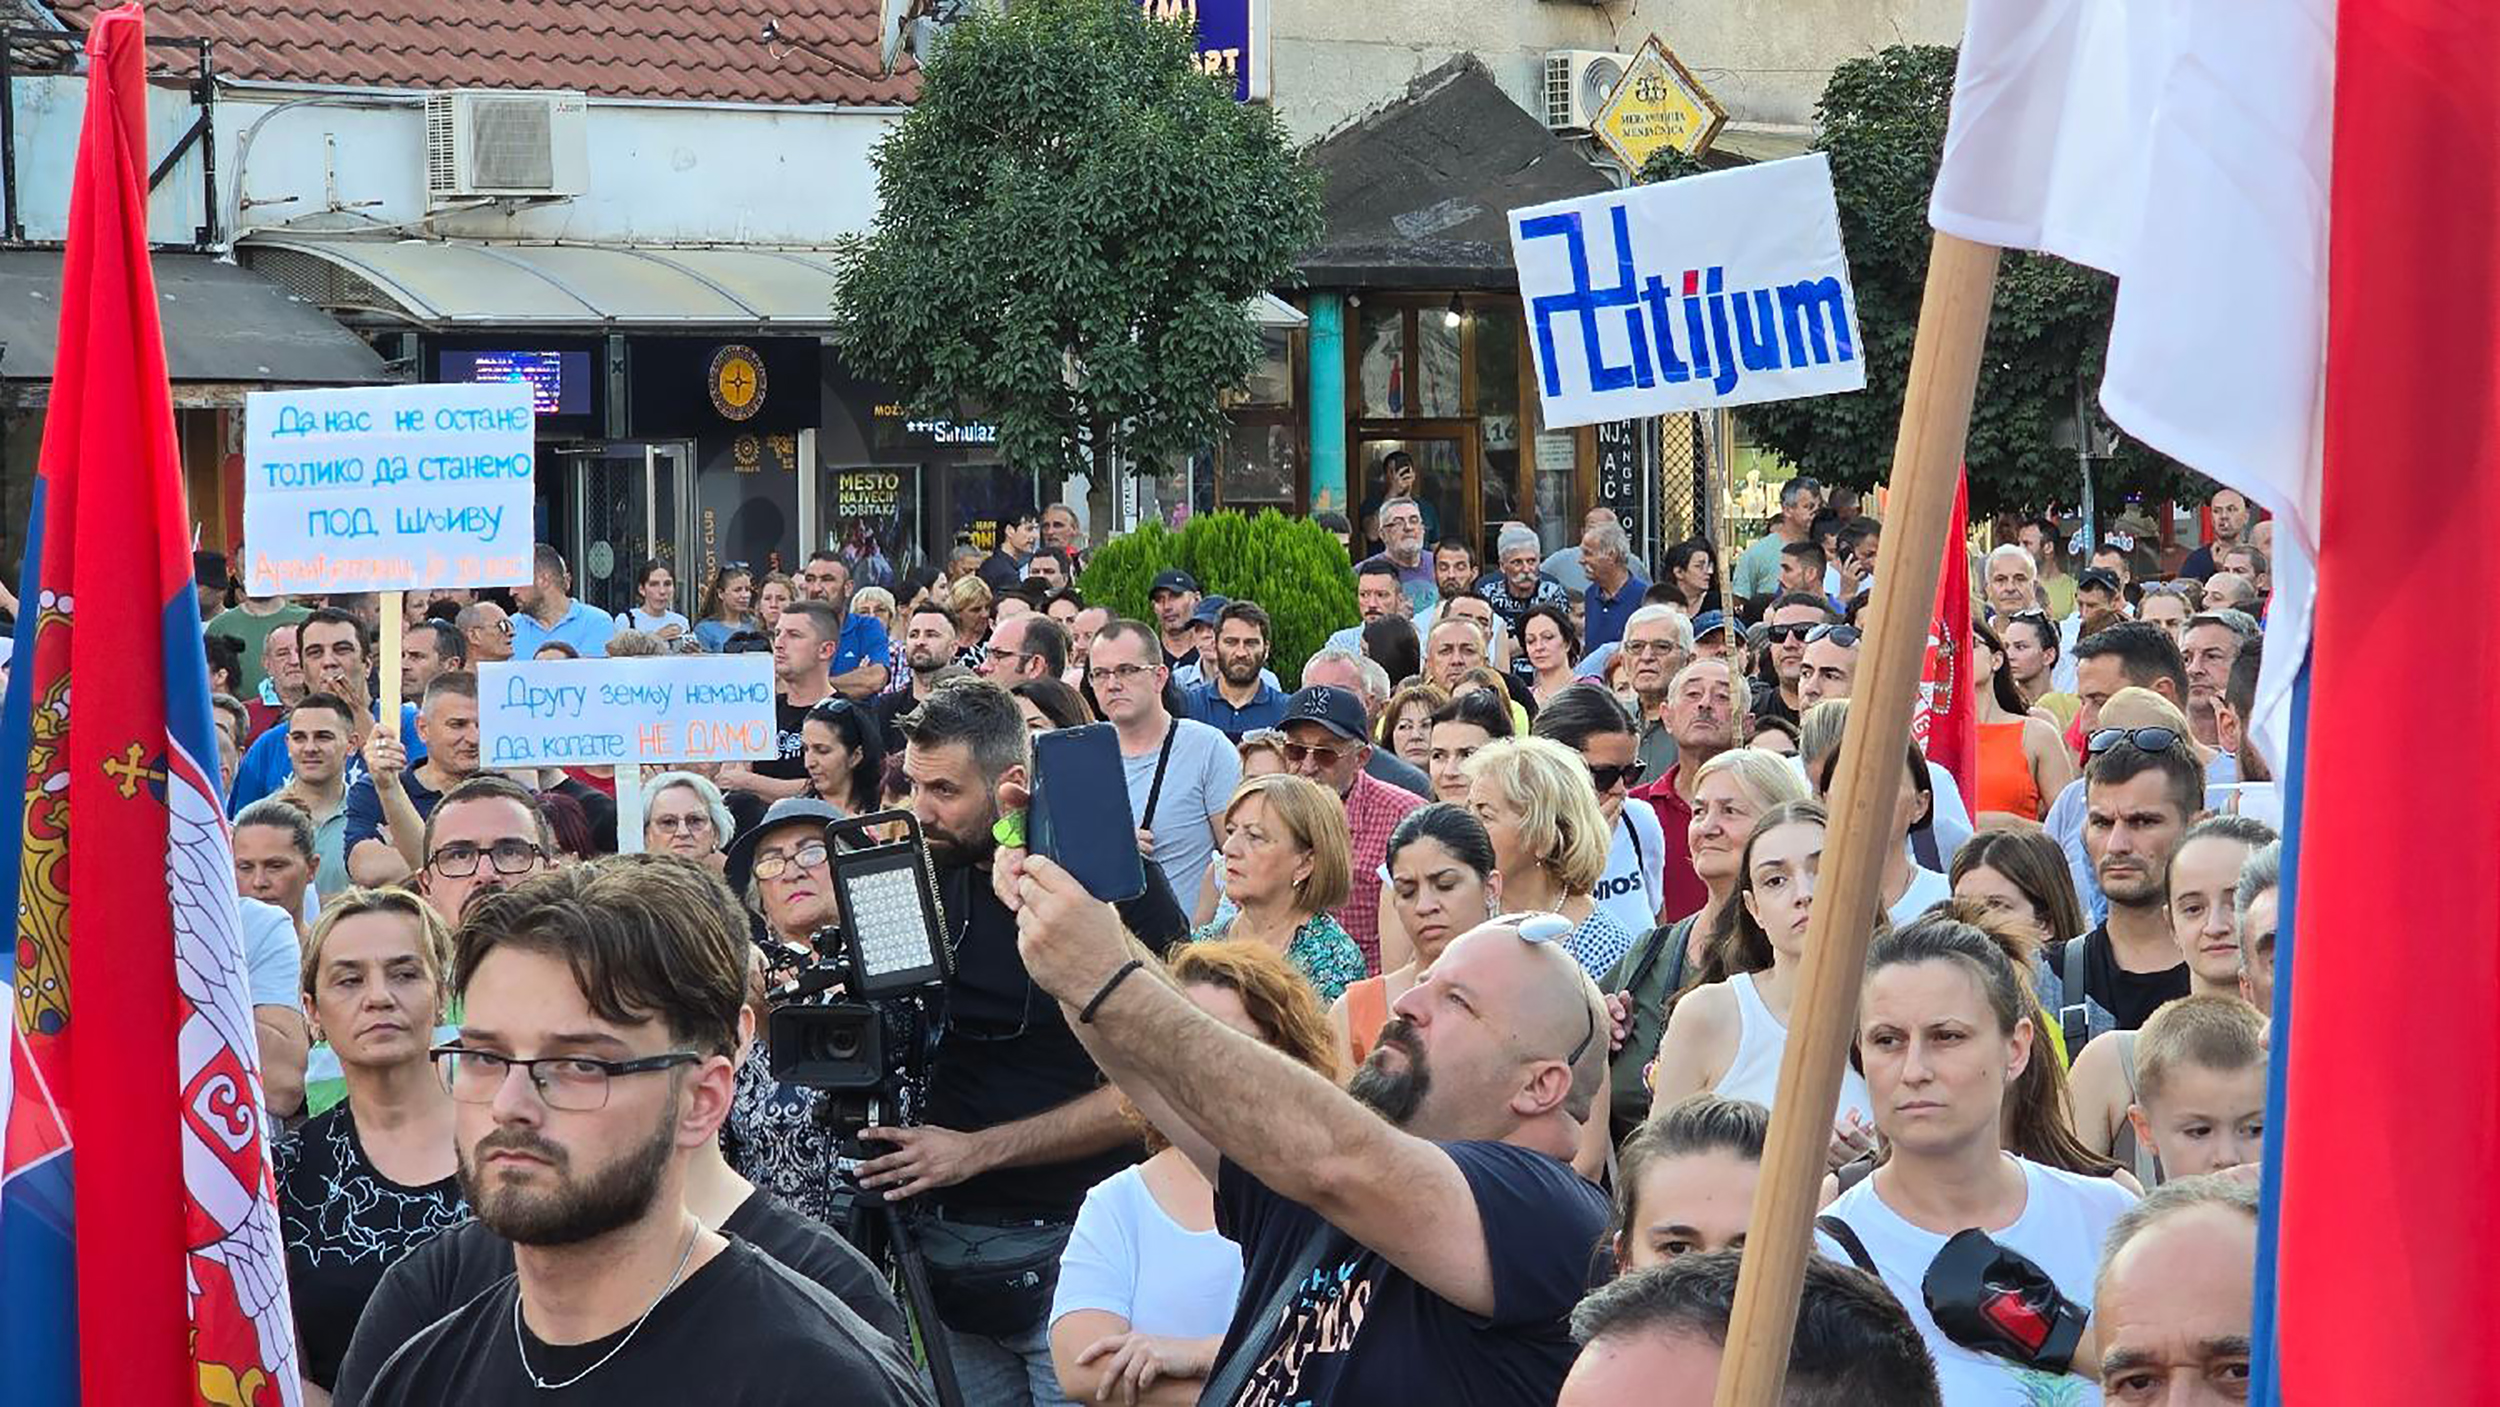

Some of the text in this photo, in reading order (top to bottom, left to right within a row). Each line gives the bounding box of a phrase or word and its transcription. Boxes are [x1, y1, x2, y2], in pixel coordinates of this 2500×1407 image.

[396, 409, 424, 432] не
[435, 406, 529, 432] остане
[262, 453, 531, 487] толико да станемо
[839, 473, 899, 490] MESTO
[308, 505, 503, 542] под шљиву
[500, 675, 587, 718] Другу
[600, 683, 673, 715] земљу
[492, 734, 535, 762] да
[542, 732, 627, 758] копате
[638, 719, 676, 755] НЕ
[685, 719, 768, 757] ДАМО
